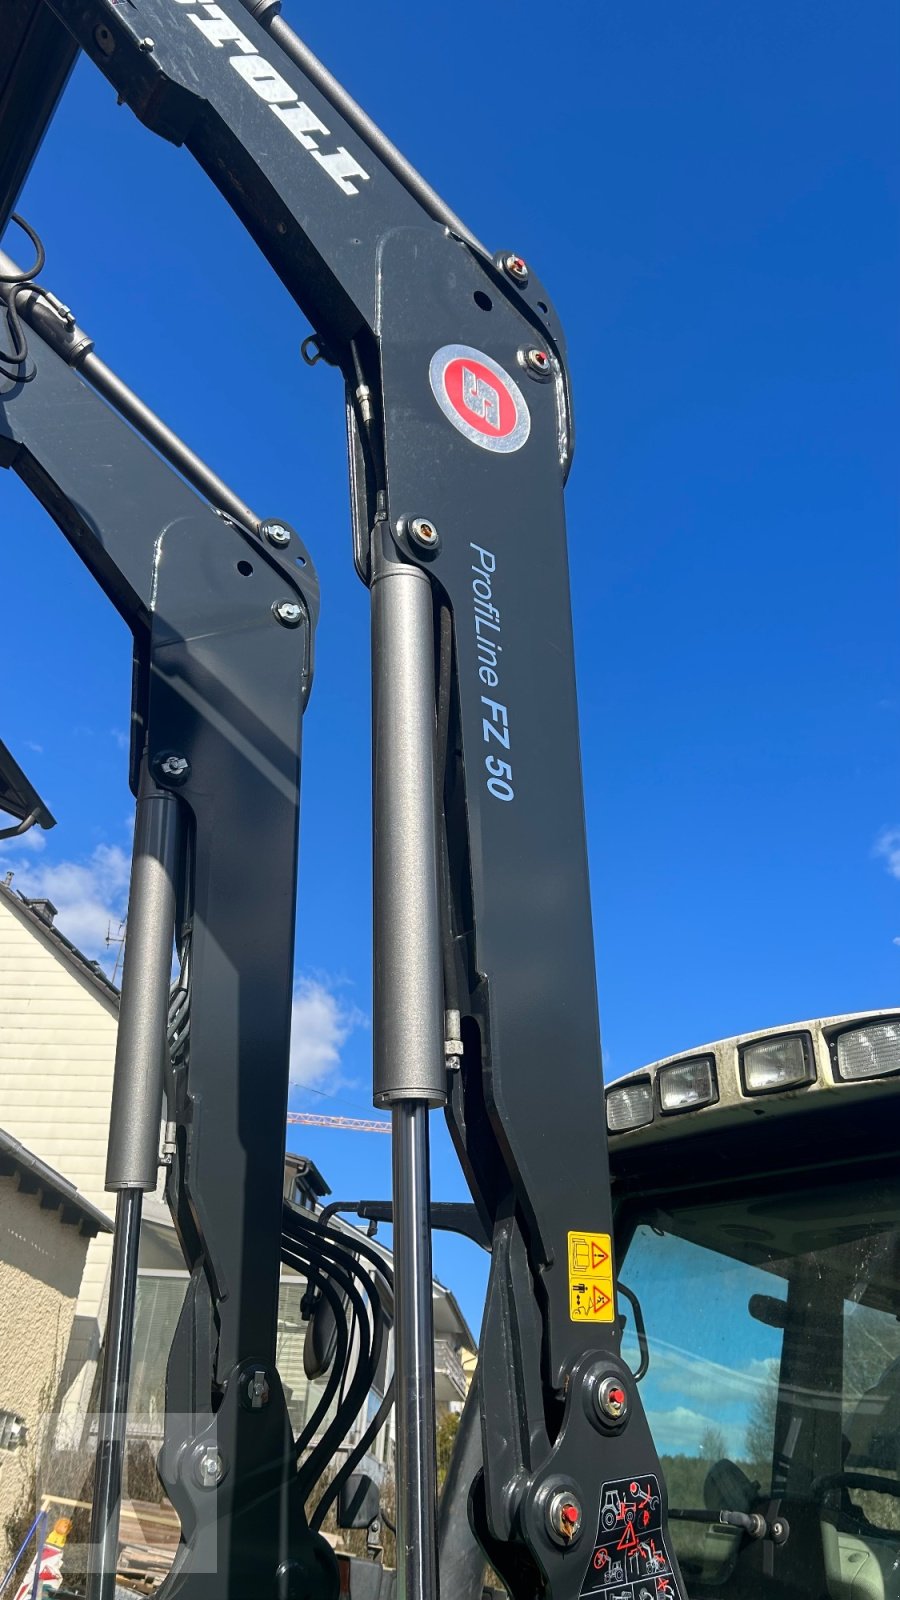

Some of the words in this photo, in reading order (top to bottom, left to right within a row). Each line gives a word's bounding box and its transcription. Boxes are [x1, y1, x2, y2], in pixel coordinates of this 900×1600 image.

[178, 0, 370, 195] TOLL
[469, 542, 503, 687] ProfiLine
[480, 695, 511, 750] FZ
[484, 755, 515, 802] 50
